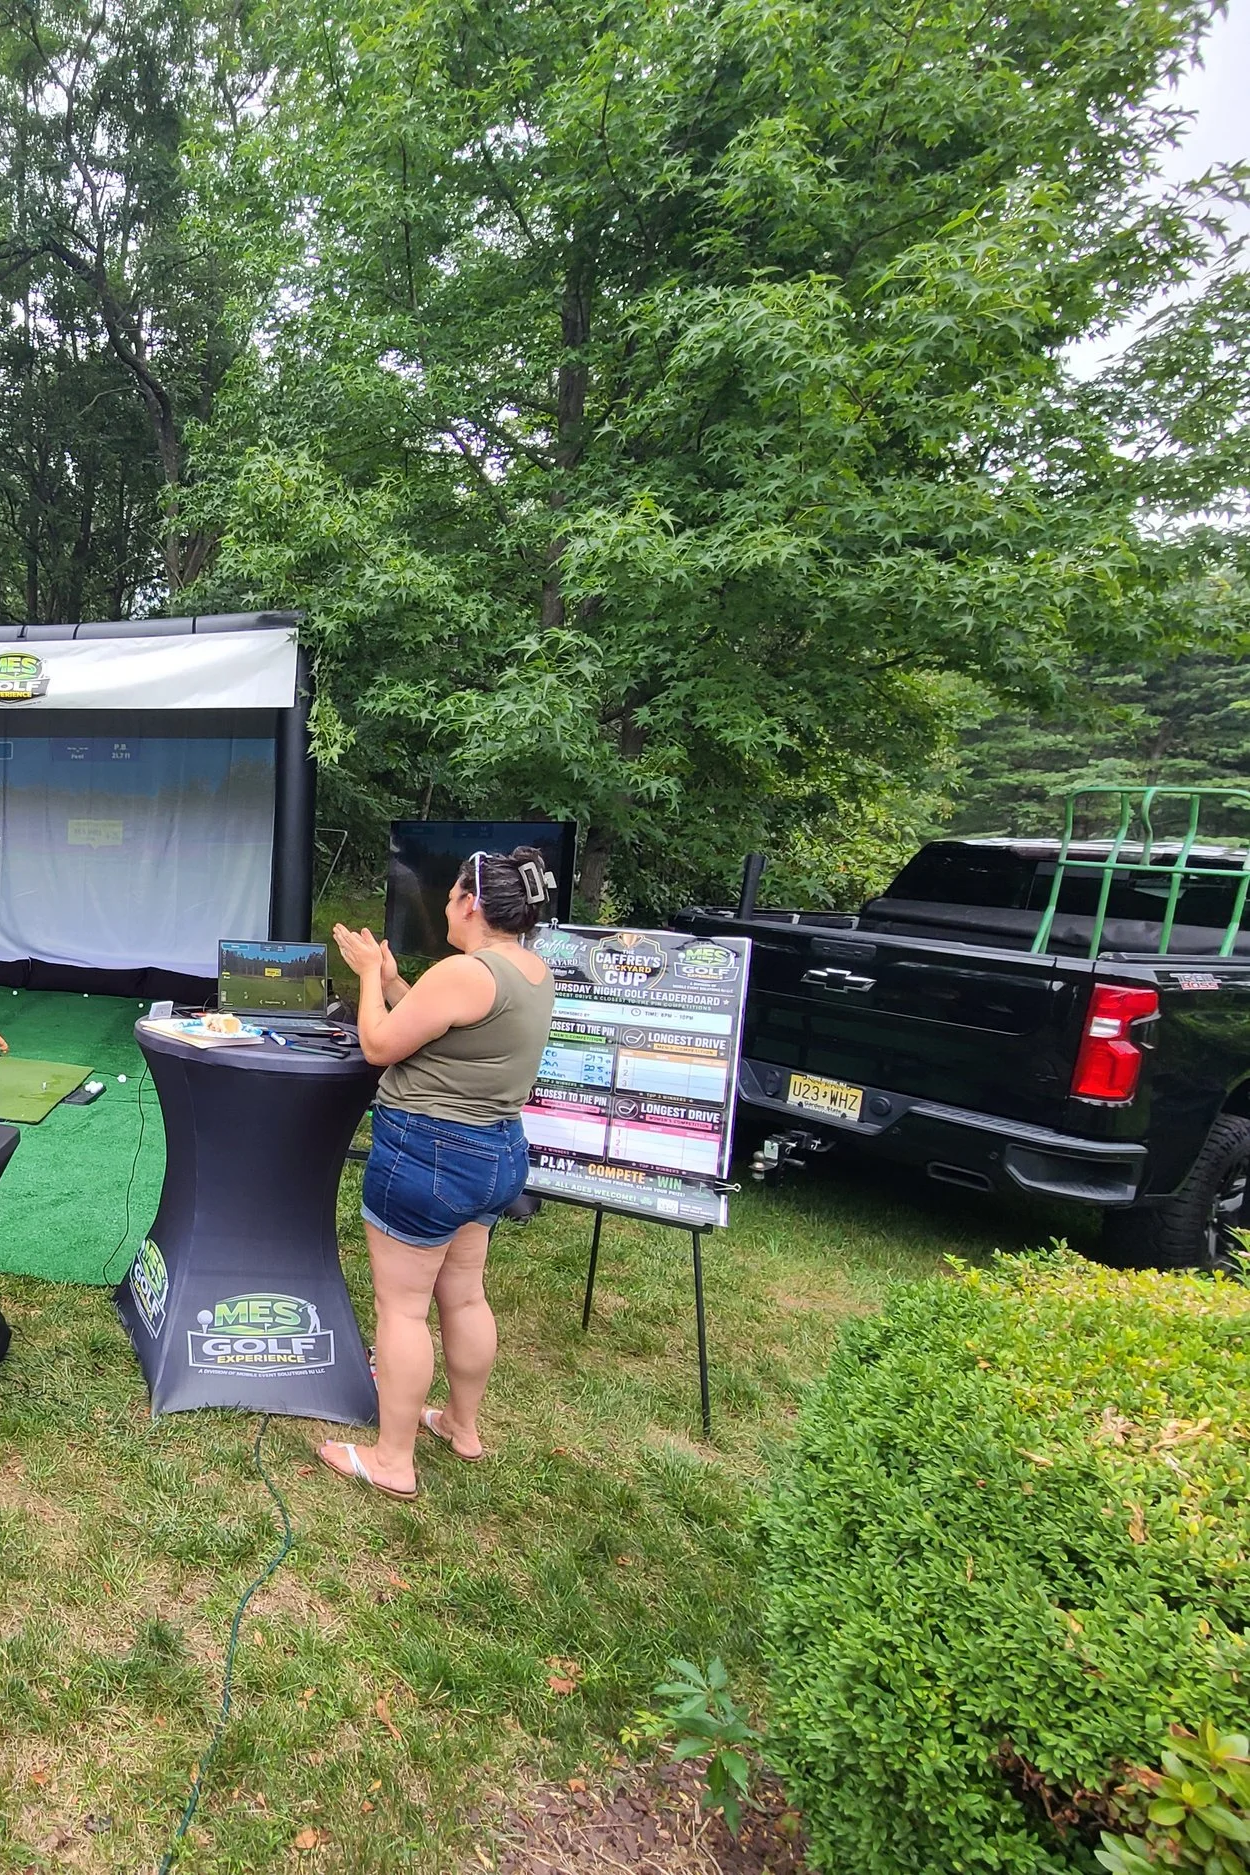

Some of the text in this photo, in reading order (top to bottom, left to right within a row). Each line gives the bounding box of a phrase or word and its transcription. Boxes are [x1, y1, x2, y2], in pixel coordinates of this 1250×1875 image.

[534, 938, 587, 954] Caffrey's
[542, 956, 578, 966] ACKYARD
[596, 952, 661, 968] CAFFREY'S
[686, 948, 727, 963] MES
[602, 963, 651, 973] BACKYARD
[682, 966, 730, 976] GOLF
[605, 970, 647, 987] CUP
[1169, 973, 1222, 983] TRAIL
[1181, 982, 1220, 990] BOSS
[554, 982, 720, 1006] URSDAY NIGHT GOLF LEADERBOARD
[663, 1002, 711, 1011] COMPETITIONS
[550, 1020, 615, 1037] OSEST TO THE PIN
[647, 1032, 726, 1049] LONGEST DRIVE
[534, 1086, 607, 1106] CLOSEST TO THE PIN
[793, 1080, 820, 1101] U23
[830, 1089, 858, 1111] WHZ
[640, 1102, 720, 1123] LONGEST DRIVE
[673, 1119, 709, 1128] COMPETITION
[617, 1128, 620, 1136] 1
[614, 1149, 619, 1157] 3
[539, 1154, 682, 1190] PLAY COMPETE WIN
[554, 1180, 570, 1189] ALL
[570, 1183, 591, 1193] AGES
[593, 1188, 636, 1202] WELCOME!
[134, 1263, 160, 1317] GOLF
[215, 1301, 301, 1327] MES
[202, 1338, 316, 1355] GOLF
[217, 1355, 306, 1363] EXPERIENCE
